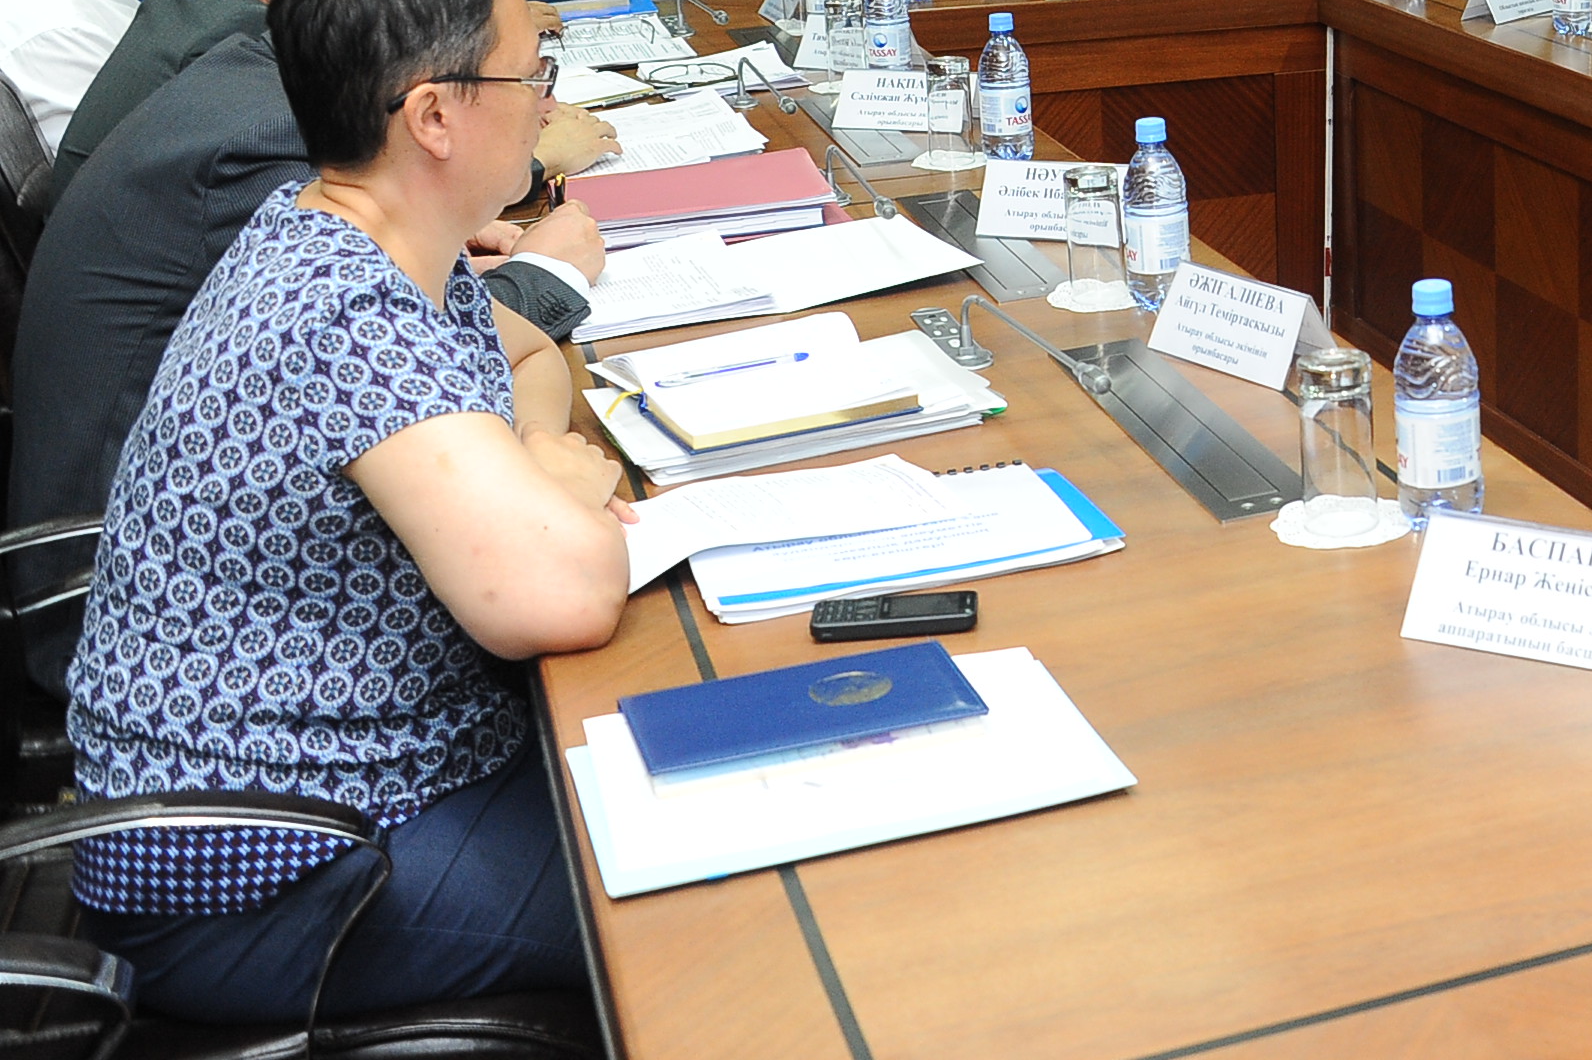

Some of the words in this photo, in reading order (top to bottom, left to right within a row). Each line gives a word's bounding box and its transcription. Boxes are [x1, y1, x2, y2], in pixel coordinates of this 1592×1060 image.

[869, 48, 897, 57] TASSAY
[876, 78, 925, 89] НАҚПА
[1005, 209, 1038, 220] Атырау
[1465, 559, 1527, 590] Ернар
[1452, 601, 1513, 626] Атырау
[1520, 612, 1584, 635] облысы
